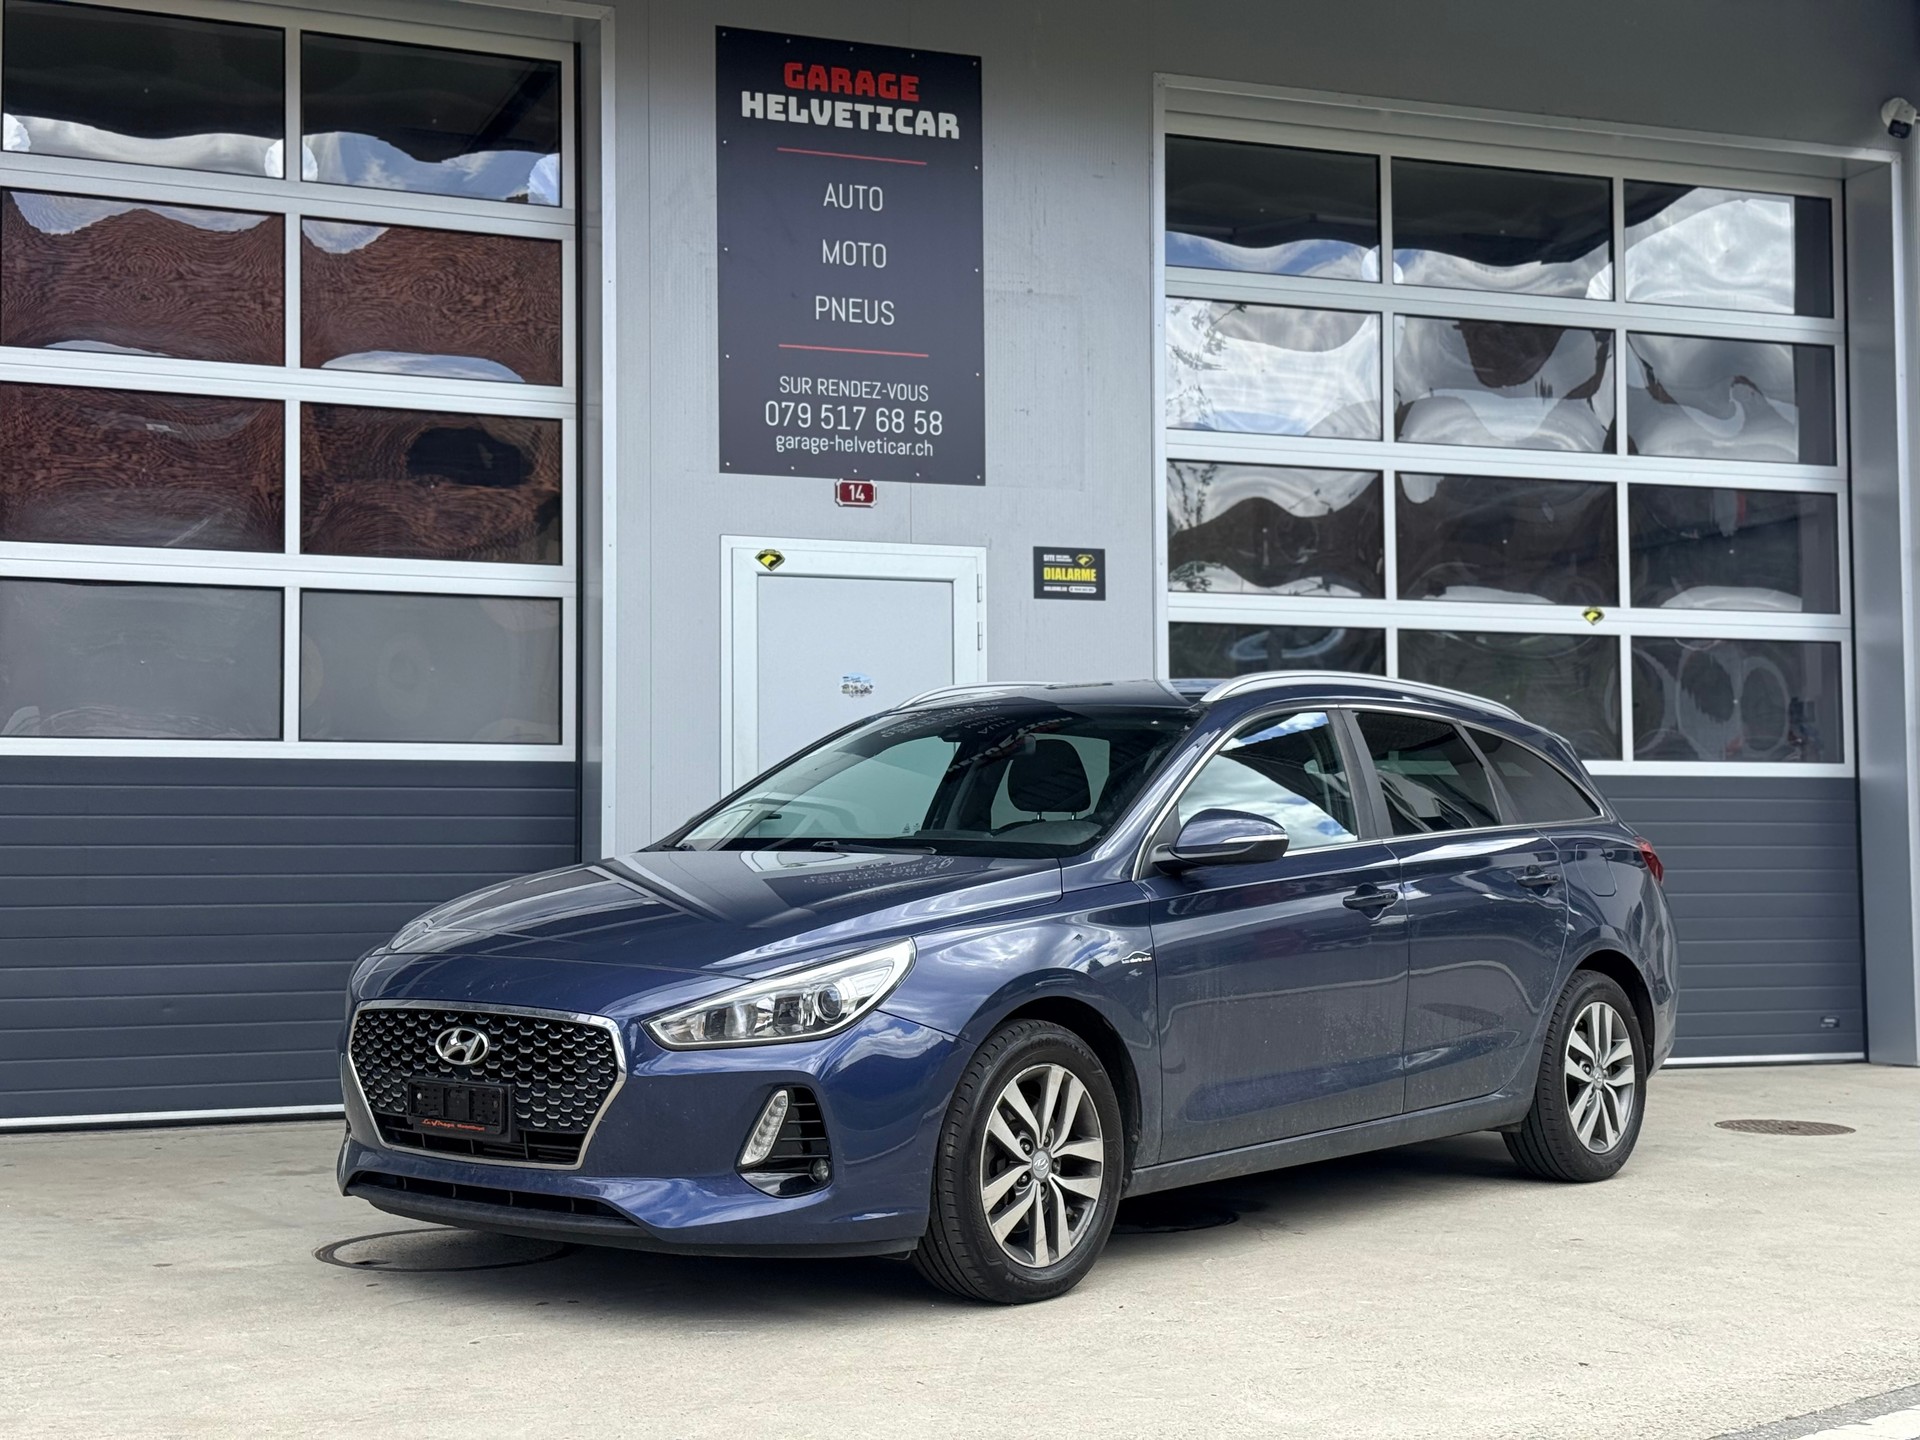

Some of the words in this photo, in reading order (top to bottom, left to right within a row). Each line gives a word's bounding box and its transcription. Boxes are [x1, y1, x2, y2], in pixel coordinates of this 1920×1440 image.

[784, 62, 920, 102] GARAGE
[741, 90, 960, 140] HELVETICAR
[823, 182, 884, 212] AUTO
[822, 239, 887, 269] MOTO
[815, 295, 896, 326] PNEUS
[779, 375, 812, 395] SUR
[817, 378, 929, 402] RENDEZ-VOUS
[765, 400, 812, 428] 079
[820, 404, 867, 431] 517
[875, 407, 905, 434] 68
[914, 410, 943, 436] 58
[775, 434, 934, 457] garage-helveticar.ch
[848, 484, 866, 502] 14
[1043, 567, 1096, 582] DIALARME
